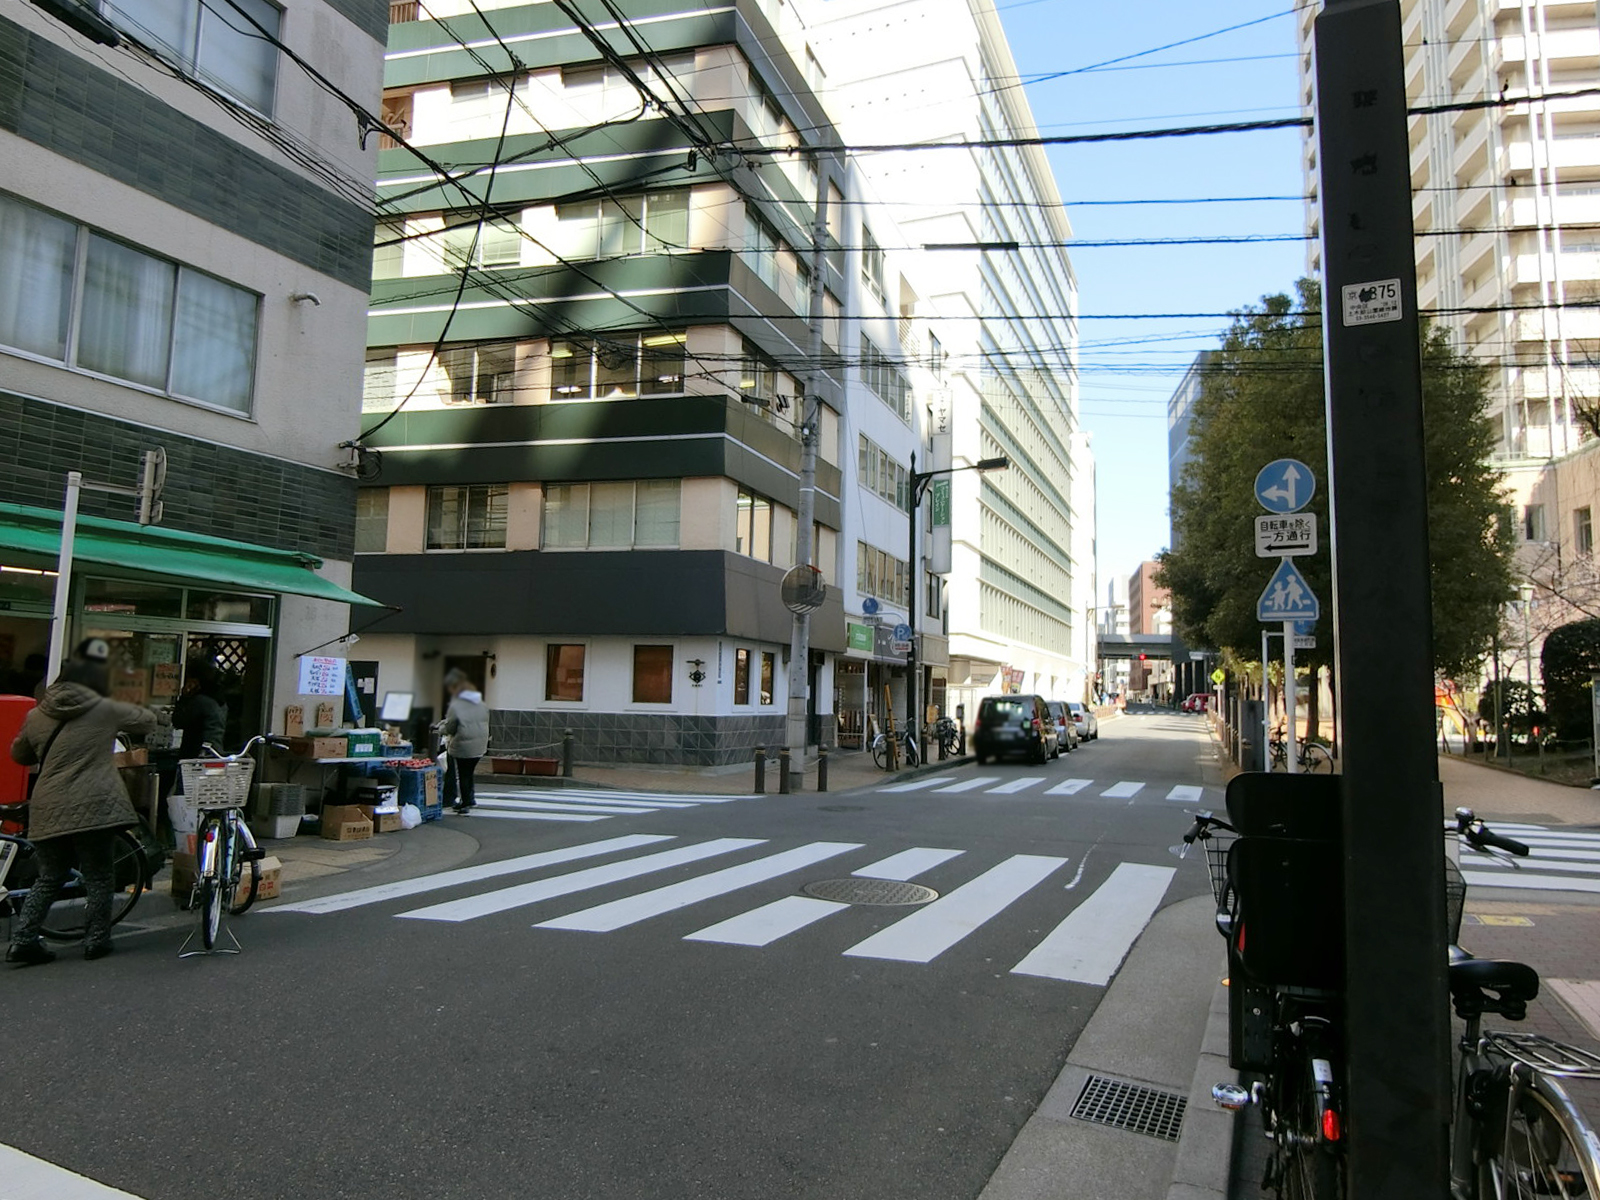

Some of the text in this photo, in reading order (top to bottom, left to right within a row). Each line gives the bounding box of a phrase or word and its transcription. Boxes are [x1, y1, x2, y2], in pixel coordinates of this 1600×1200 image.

[1260, 518, 1311, 531] 自転車を除く
[1260, 530, 1311, 542] 一方通行
